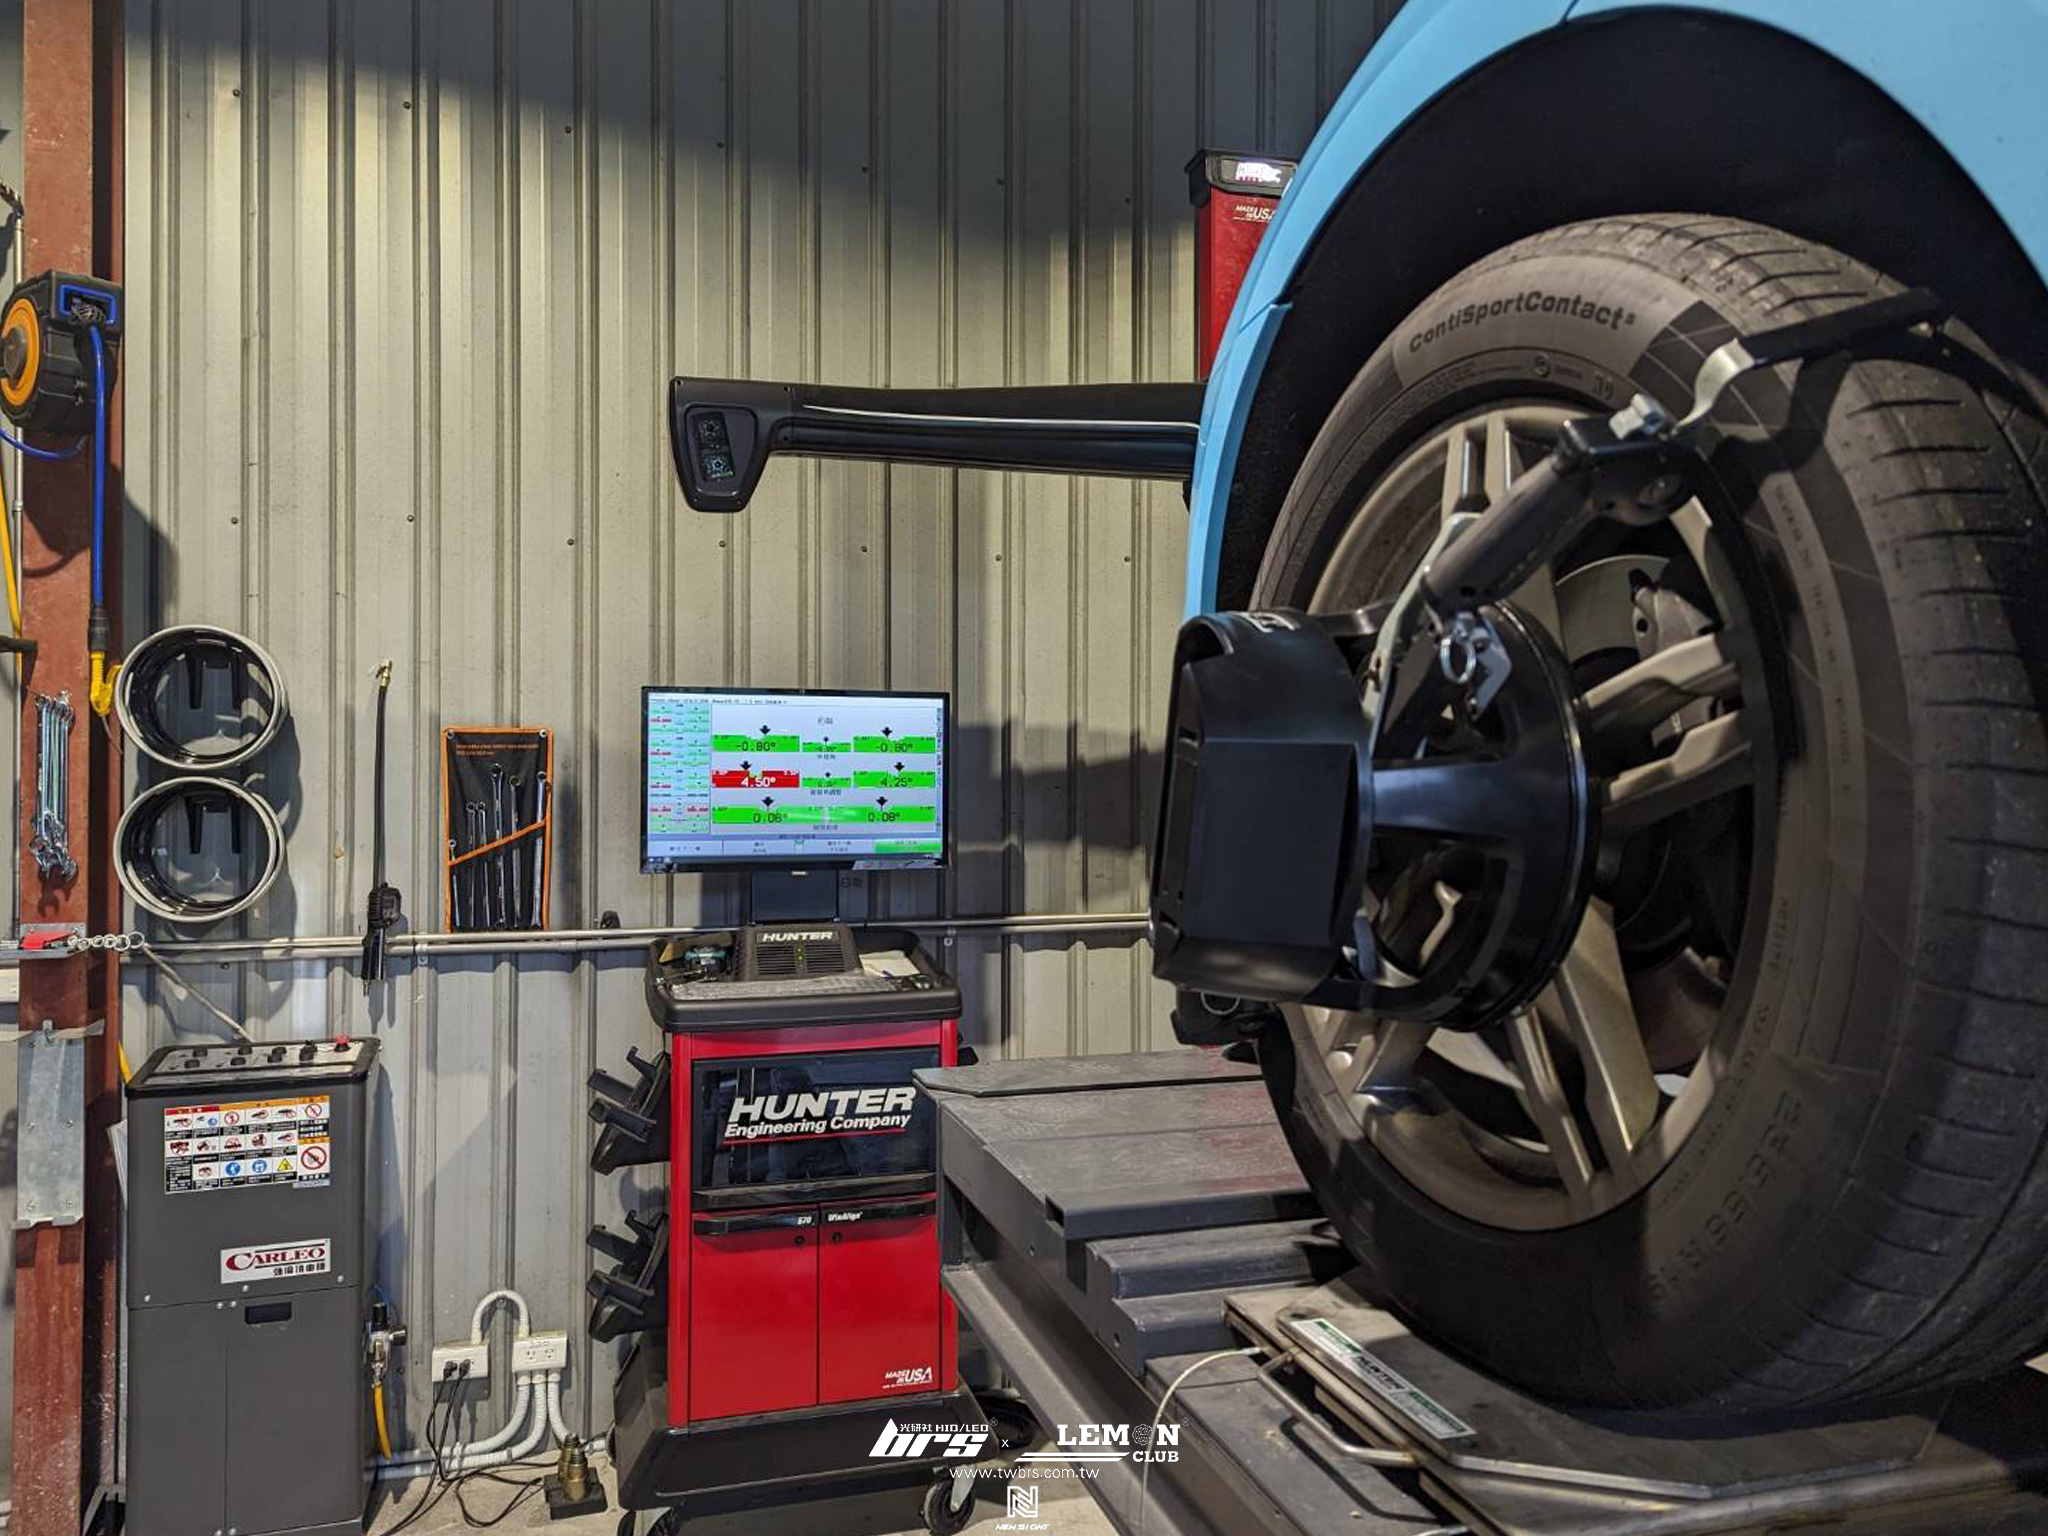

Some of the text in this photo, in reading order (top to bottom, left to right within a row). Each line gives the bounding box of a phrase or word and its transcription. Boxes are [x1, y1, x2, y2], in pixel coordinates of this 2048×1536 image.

[761, 930, 833, 942] HUNTER
[728, 1086, 917, 1122] HUNTER
[724, 1114, 911, 1139] Engineering Company
[225, 1246, 326, 1271] CARLEO
[904, 1366, 932, 1382] USA
